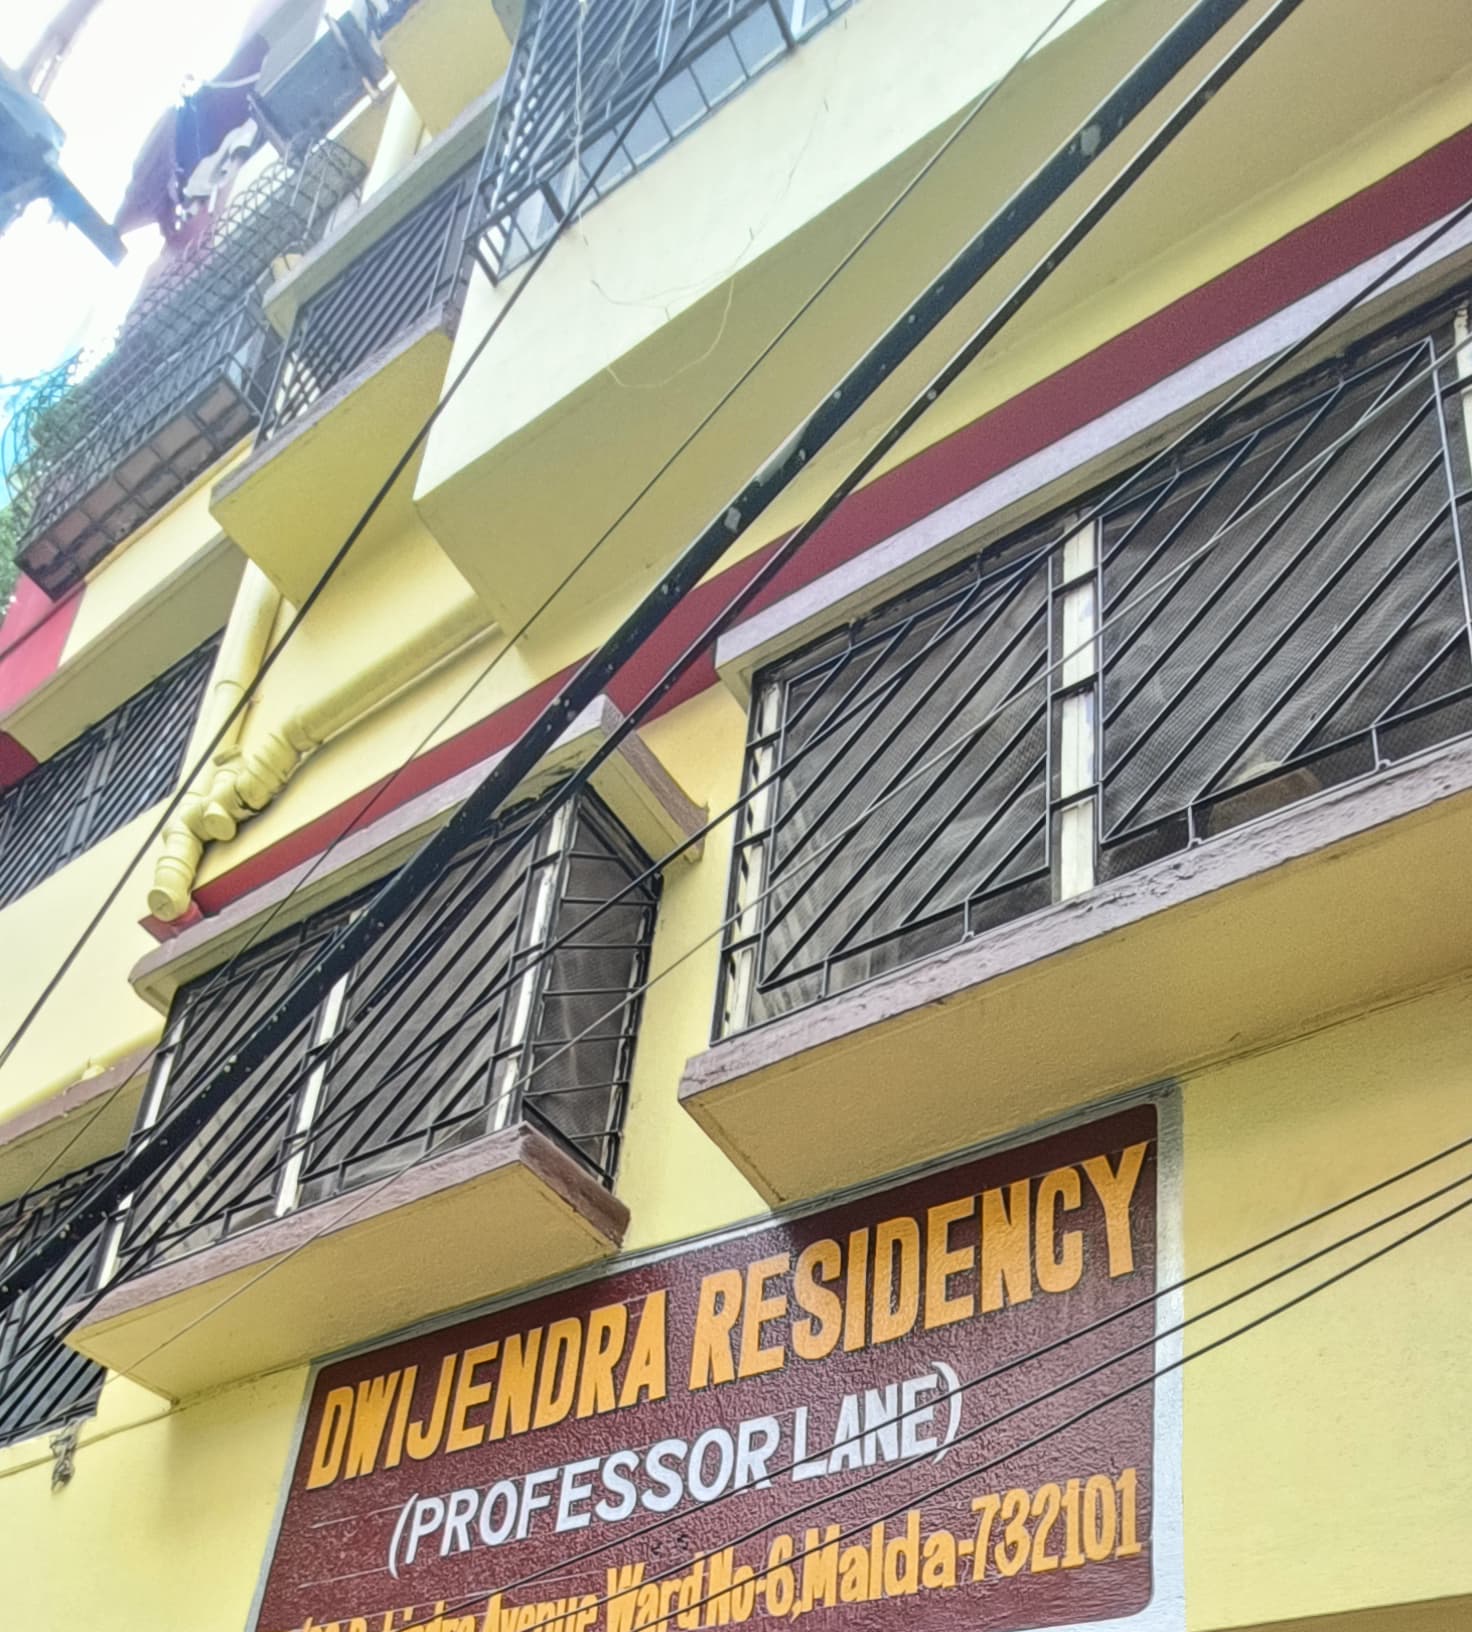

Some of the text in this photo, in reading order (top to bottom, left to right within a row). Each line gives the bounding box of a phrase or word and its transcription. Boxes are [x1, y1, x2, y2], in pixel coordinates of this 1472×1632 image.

[306, 1141, 1148, 1490] DWIJENDRA RESIDENCY
[388, 1361, 963, 1578] (PROFESSOR LANE)
